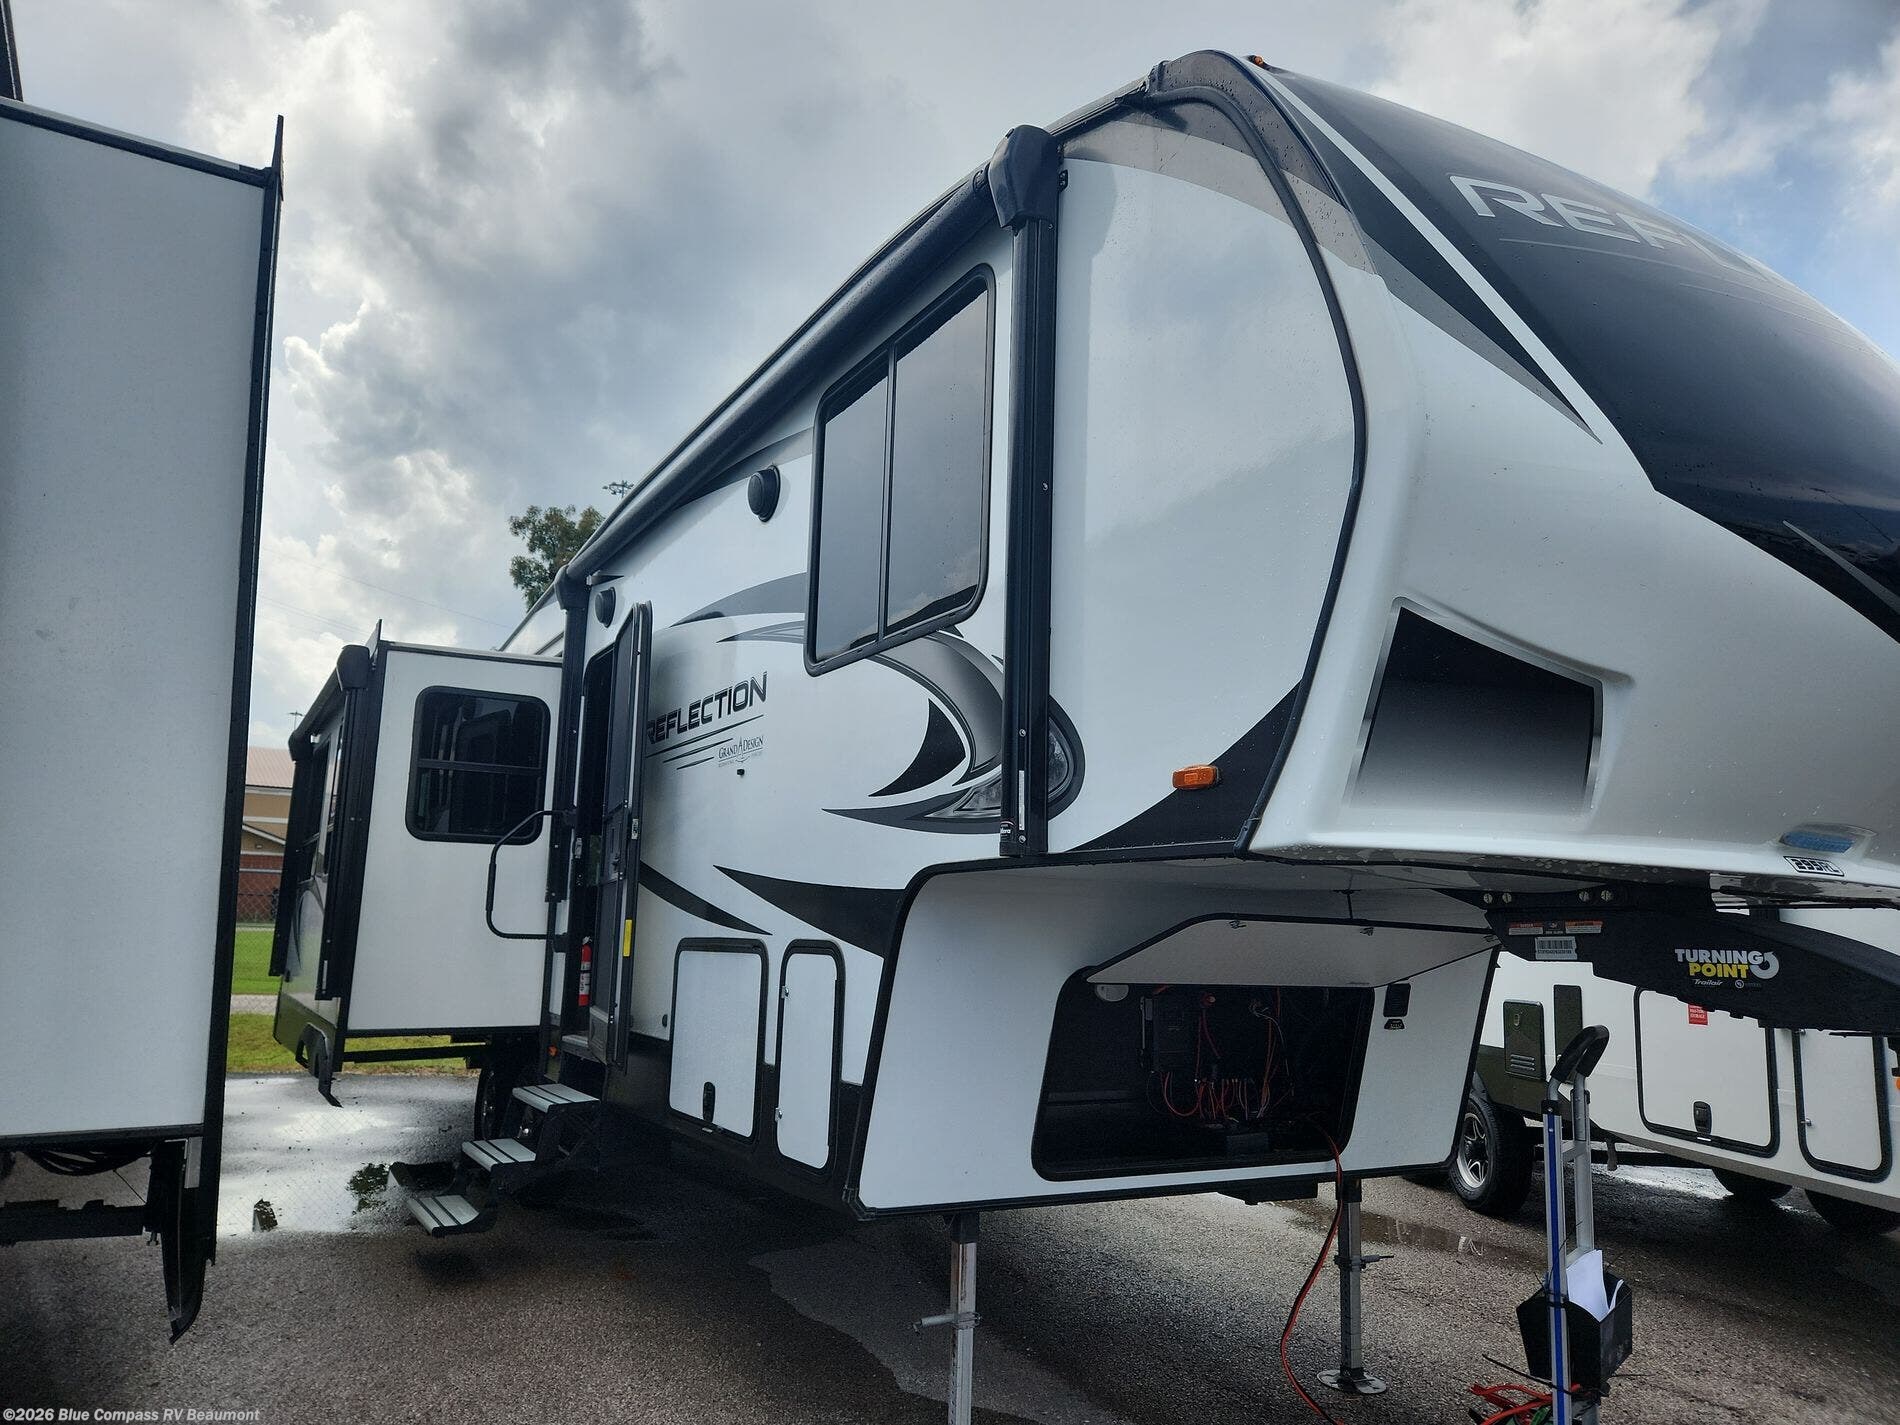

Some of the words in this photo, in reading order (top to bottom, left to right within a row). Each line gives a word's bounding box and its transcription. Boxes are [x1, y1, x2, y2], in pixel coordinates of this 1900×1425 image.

[646, 671, 767, 744] REFLECTION
[1790, 859, 1841, 873] 295RL
[1675, 948, 1763, 965] TURNING
[1689, 962, 1749, 979] POINT
